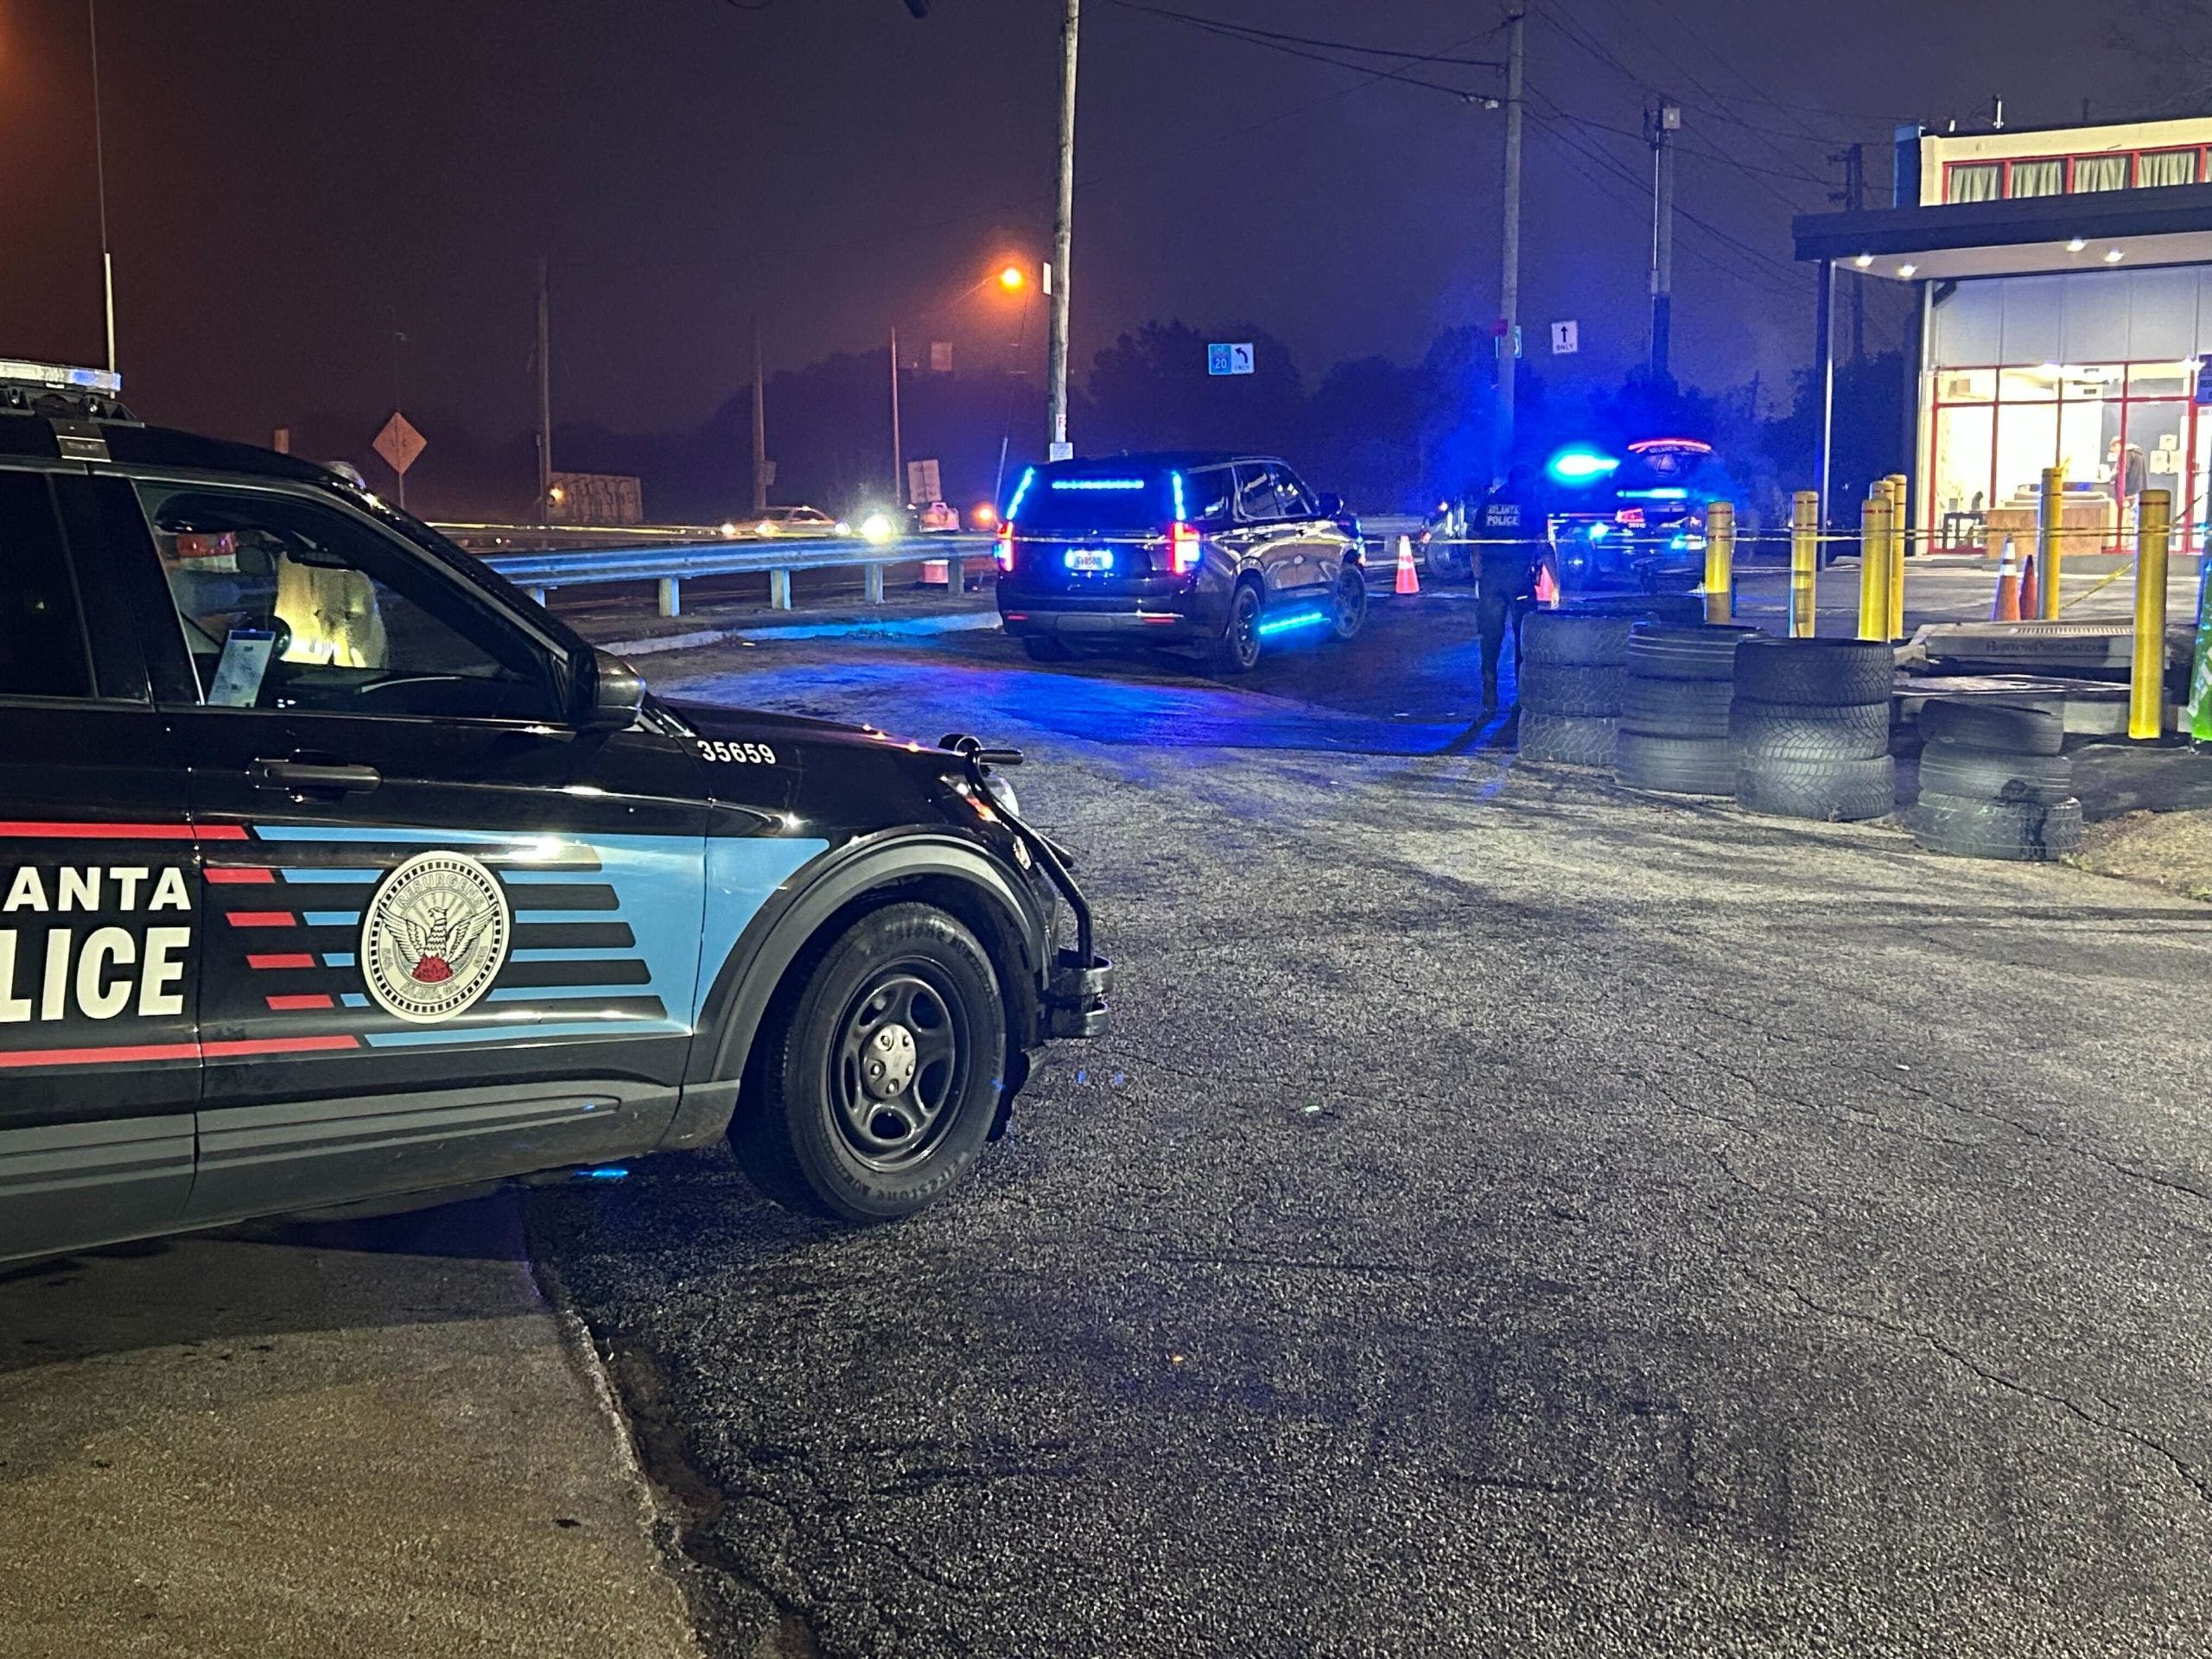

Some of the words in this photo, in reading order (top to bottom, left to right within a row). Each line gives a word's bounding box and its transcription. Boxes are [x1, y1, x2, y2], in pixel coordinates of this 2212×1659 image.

[1215, 358, 1227, 369] 20
[1488, 505, 1520, 515] ATLANTA
[1487, 515, 1520, 527] POLICE
[696, 741, 776, 764] 35659
[396, 874, 485, 907] RESURGENS
